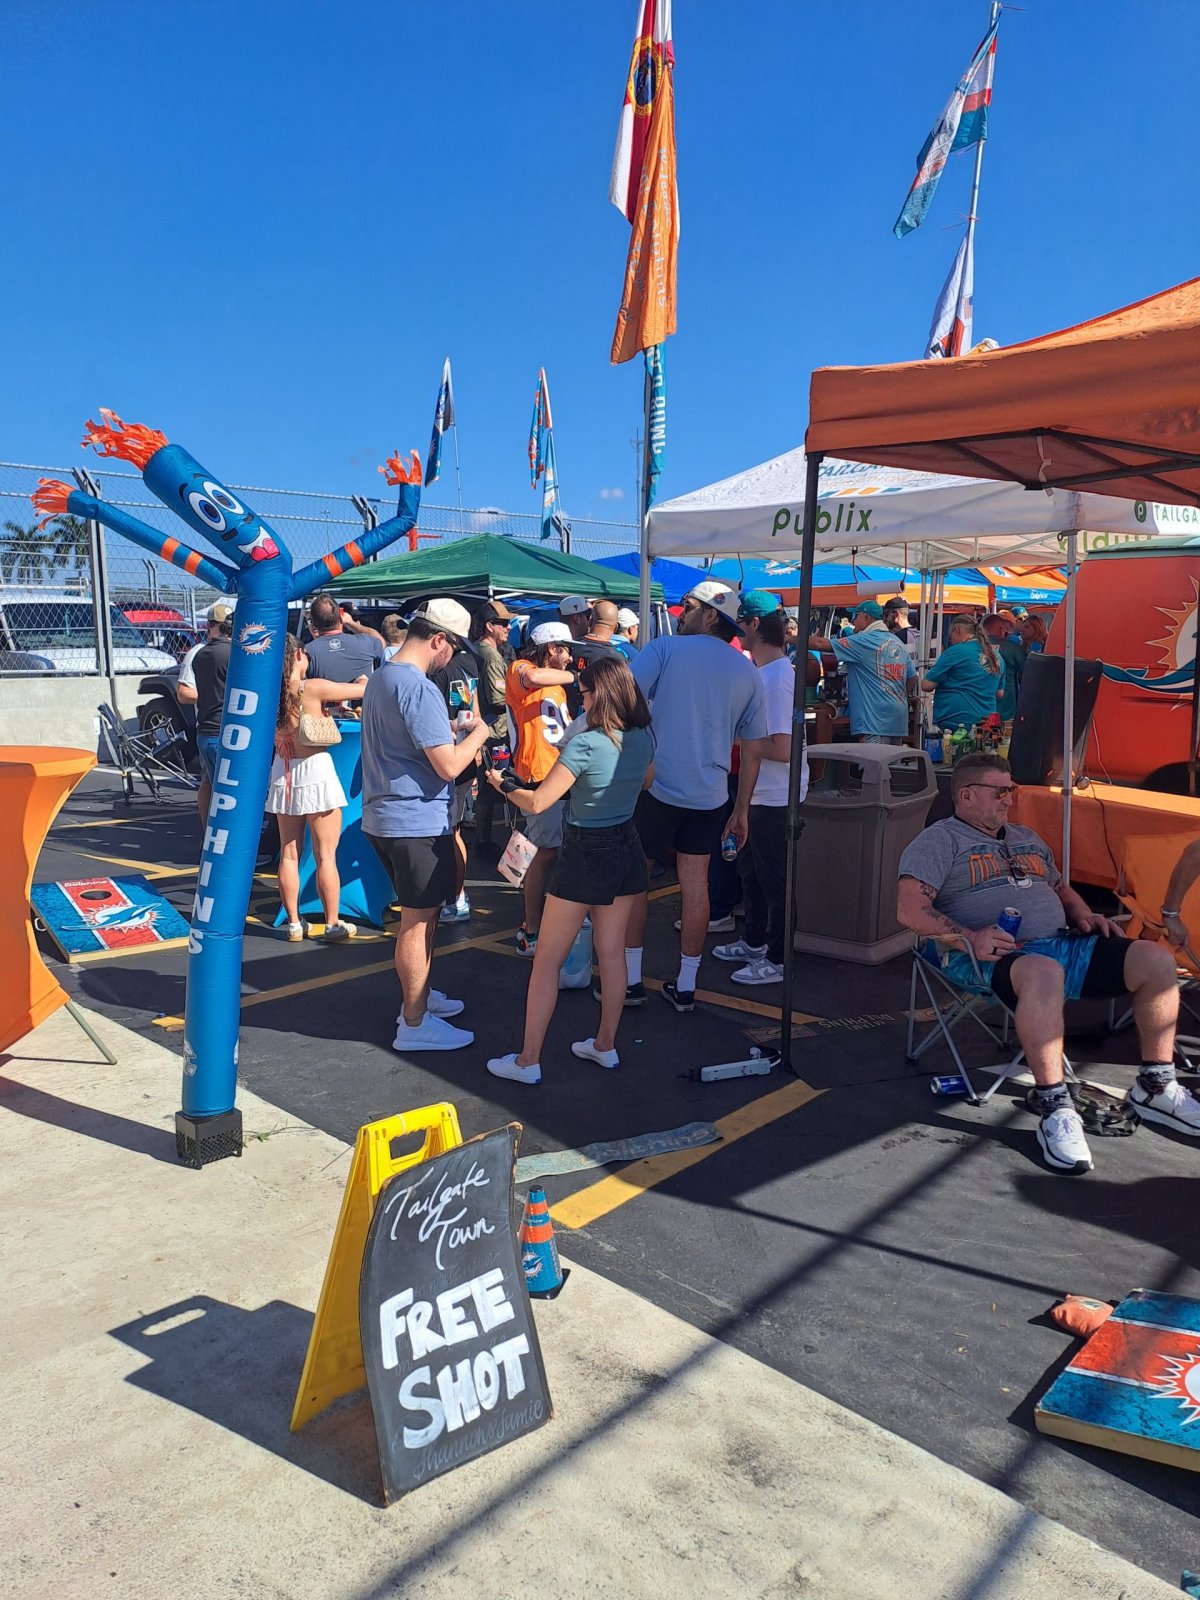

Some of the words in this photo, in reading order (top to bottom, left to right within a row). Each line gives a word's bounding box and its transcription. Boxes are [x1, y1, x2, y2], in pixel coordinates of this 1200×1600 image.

[188, 687, 259, 954] DOLPHINS
[384, 1161, 491, 1243] Tailgate
[434, 1207, 496, 1271] Town
[379, 1267, 516, 1370] FREE
[398, 1333, 530, 1449] SHOT
